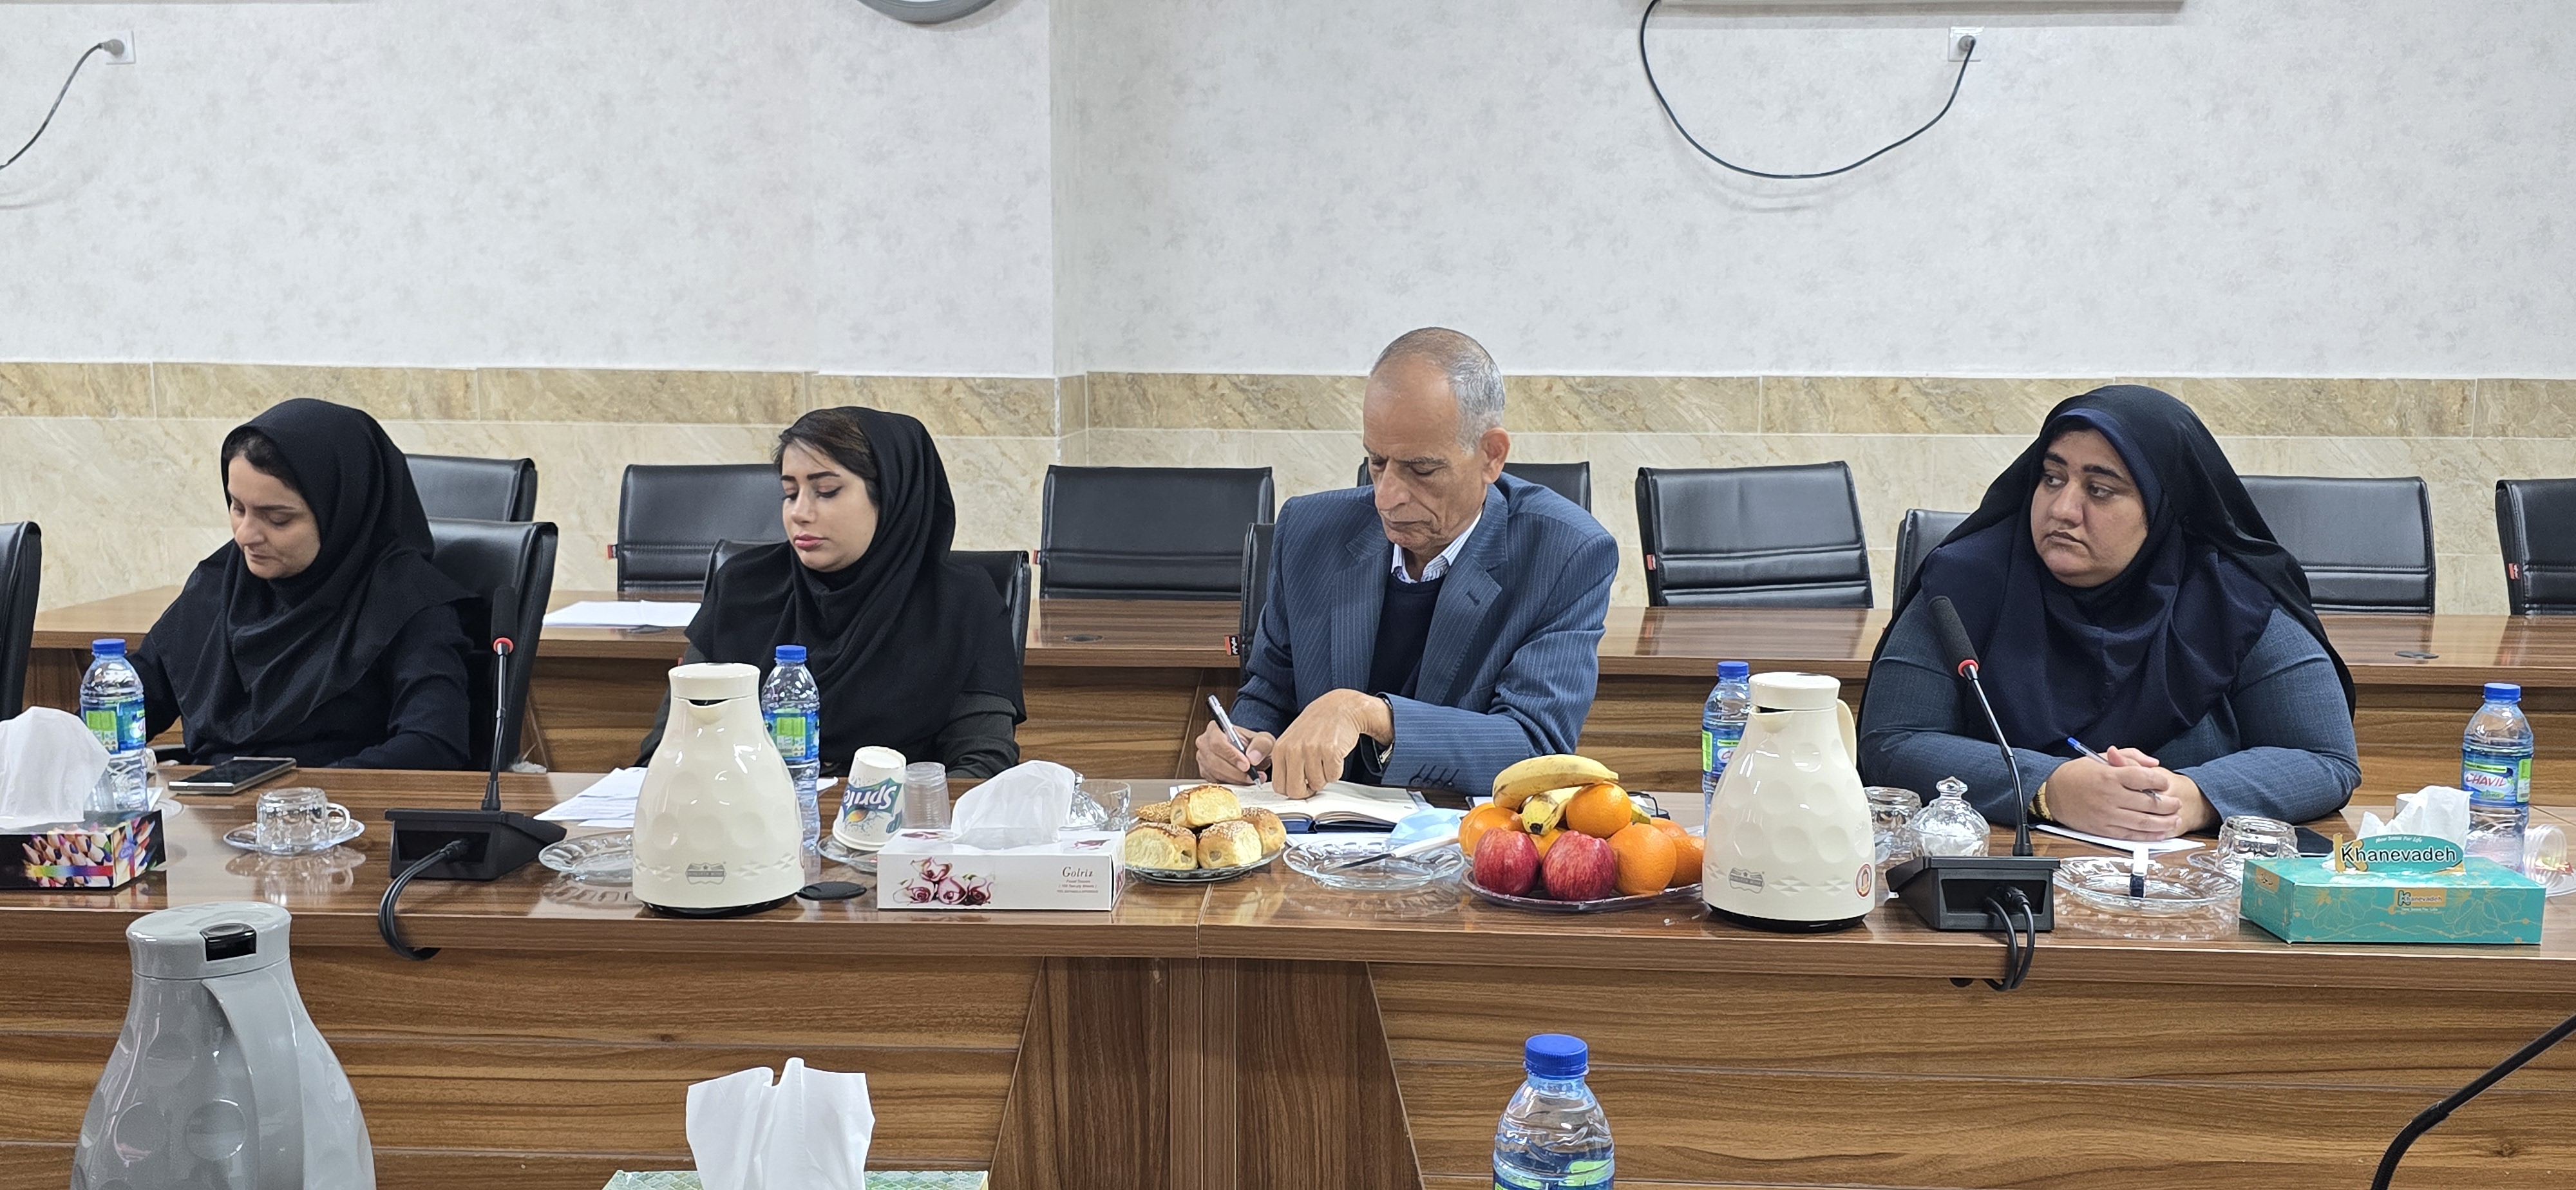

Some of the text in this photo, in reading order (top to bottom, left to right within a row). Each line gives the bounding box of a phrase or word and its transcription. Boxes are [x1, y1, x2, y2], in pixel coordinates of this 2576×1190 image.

[2465, 773, 2508, 787] CHAVIL
[843, 784, 897, 811] Sprite
[2340, 846, 2456, 862] Khanevadeh
[1062, 866, 1093, 877] Golriz
